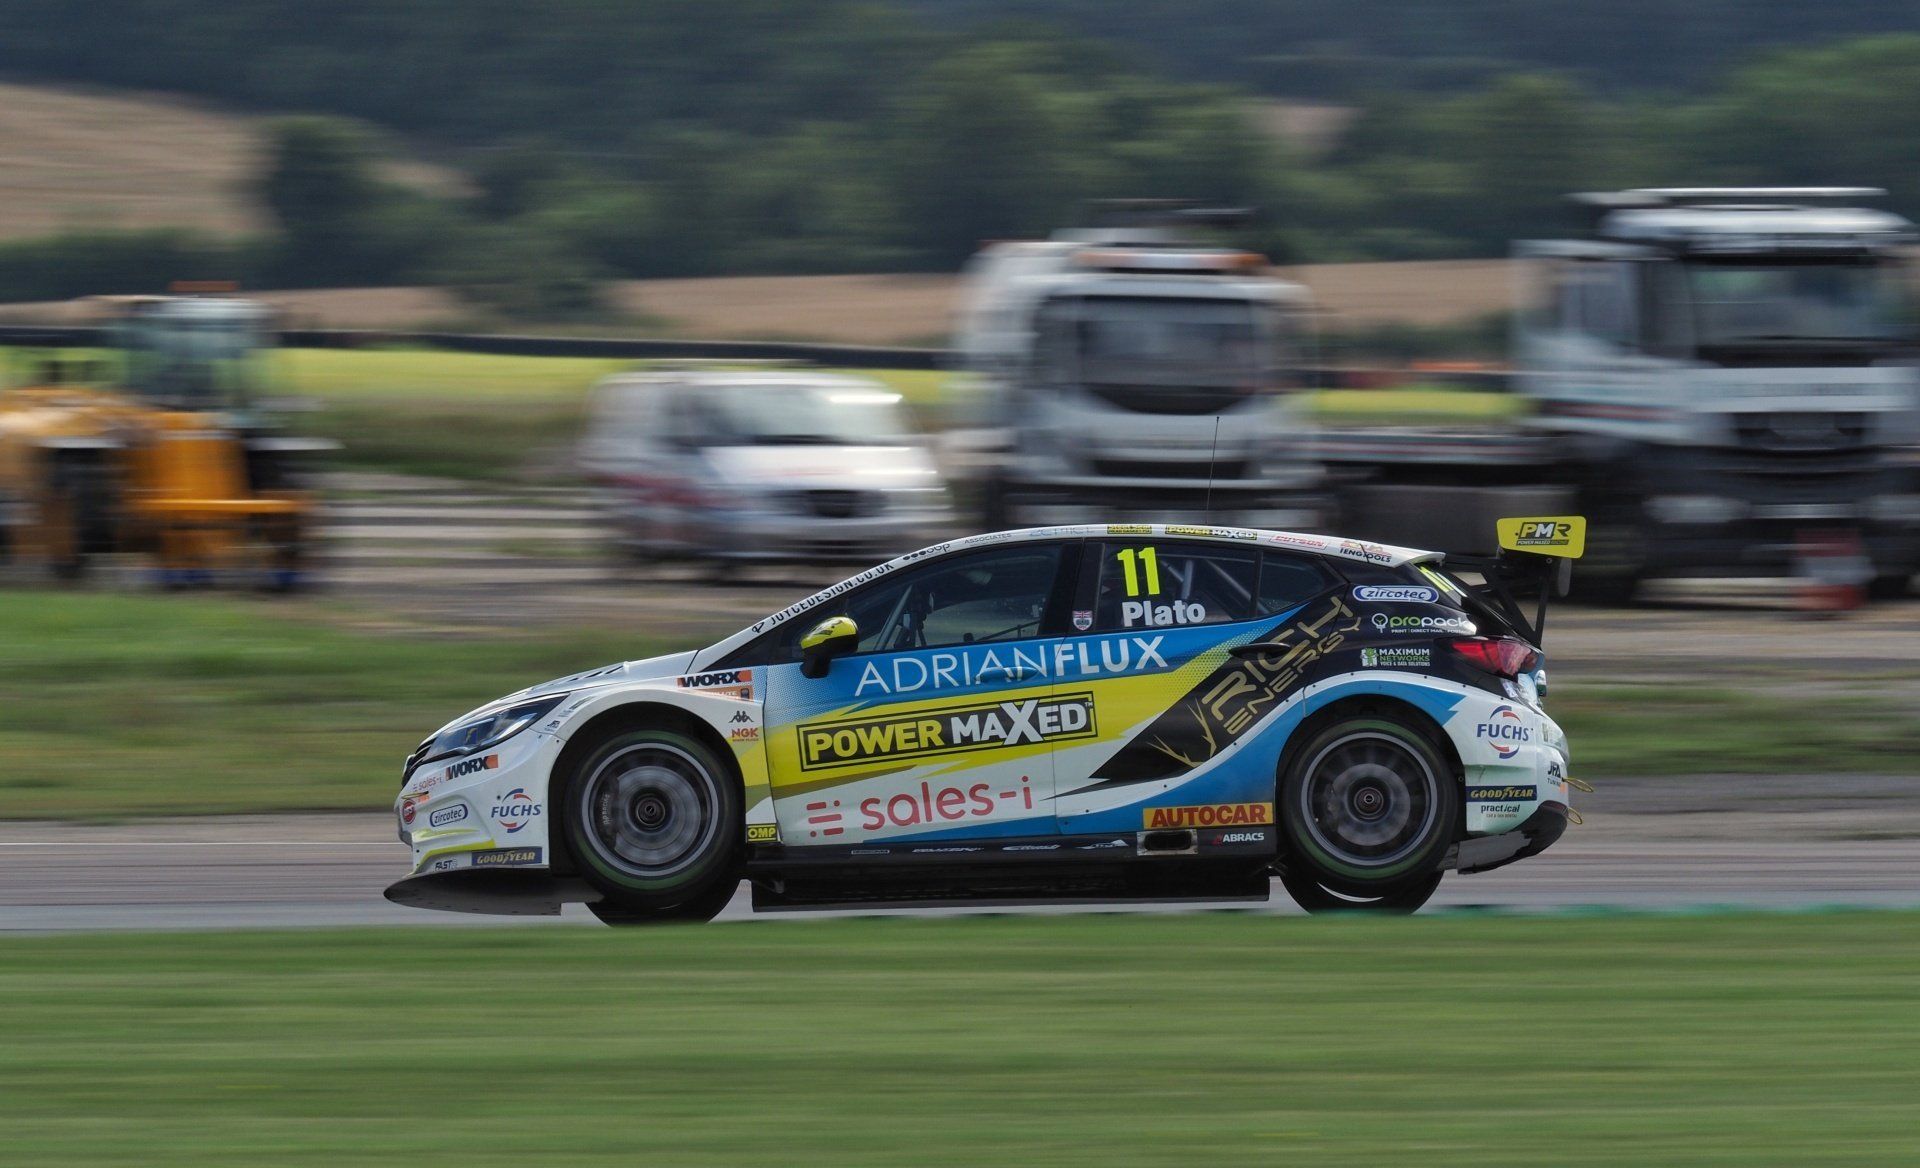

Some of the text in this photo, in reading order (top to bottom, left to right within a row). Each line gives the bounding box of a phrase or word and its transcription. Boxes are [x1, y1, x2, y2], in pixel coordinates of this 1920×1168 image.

[1168, 526, 1254, 538] POWER MAXED
[1520, 523, 1572, 538] PMR
[1117, 547, 1160, 597] 11
[1366, 589, 1427, 600] zircotec
[1121, 600, 1206, 628] Plato
[1390, 616, 1467, 628] propack
[1379, 648, 1430, 656] MAXIMUM
[681, 671, 742, 688] WORX
[731, 727, 759, 738] NGK
[1477, 723, 1529, 741] FUCHS
[808, 719, 945, 762] POWER
[447, 755, 492, 780] WORX
[1471, 786, 1534, 800] GOODYEAR
[860, 775, 1033, 831] sales-i
[1480, 804, 1521, 814] practical
[434, 808, 463, 824] zircotec
[491, 804, 542, 818] FUCHS
[1151, 804, 1266, 828] AUTOCAR
[747, 826, 776, 839] OMP
[1222, 832, 1265, 843] ABRACS
[476, 850, 536, 865] GOODYEAR
